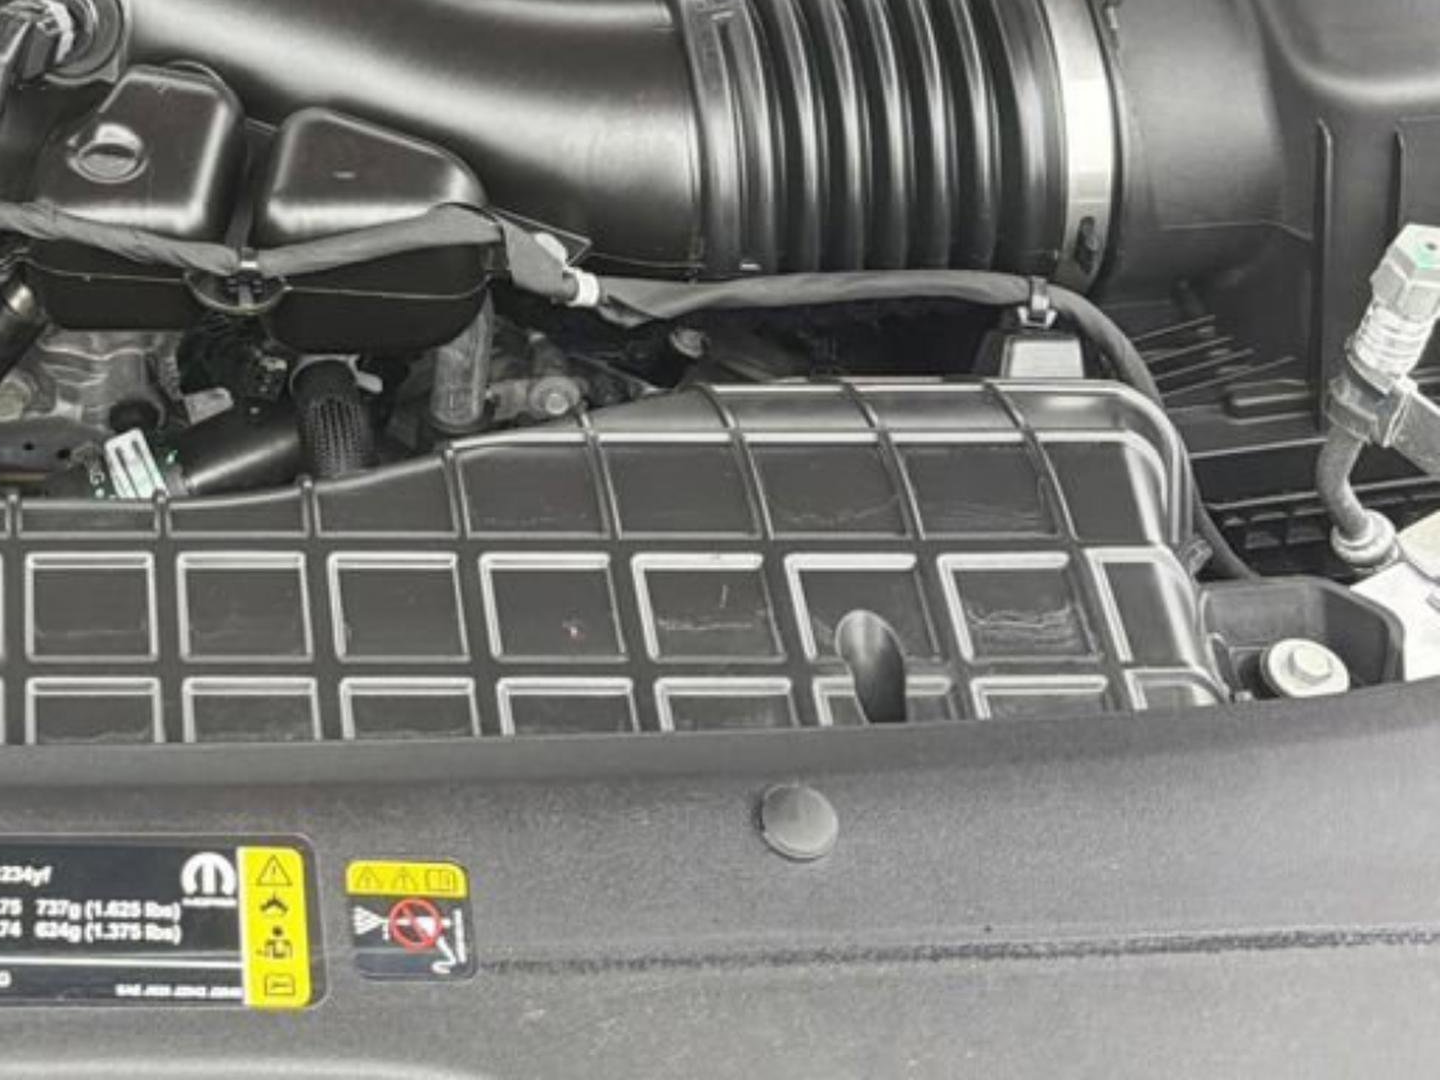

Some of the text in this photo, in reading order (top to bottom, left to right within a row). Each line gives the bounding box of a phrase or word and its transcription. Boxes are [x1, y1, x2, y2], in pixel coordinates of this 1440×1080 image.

[35, 899, 82, 921] 737g
[144, 901, 181, 923] lbs)
[144, 923, 182, 945] lbs)
